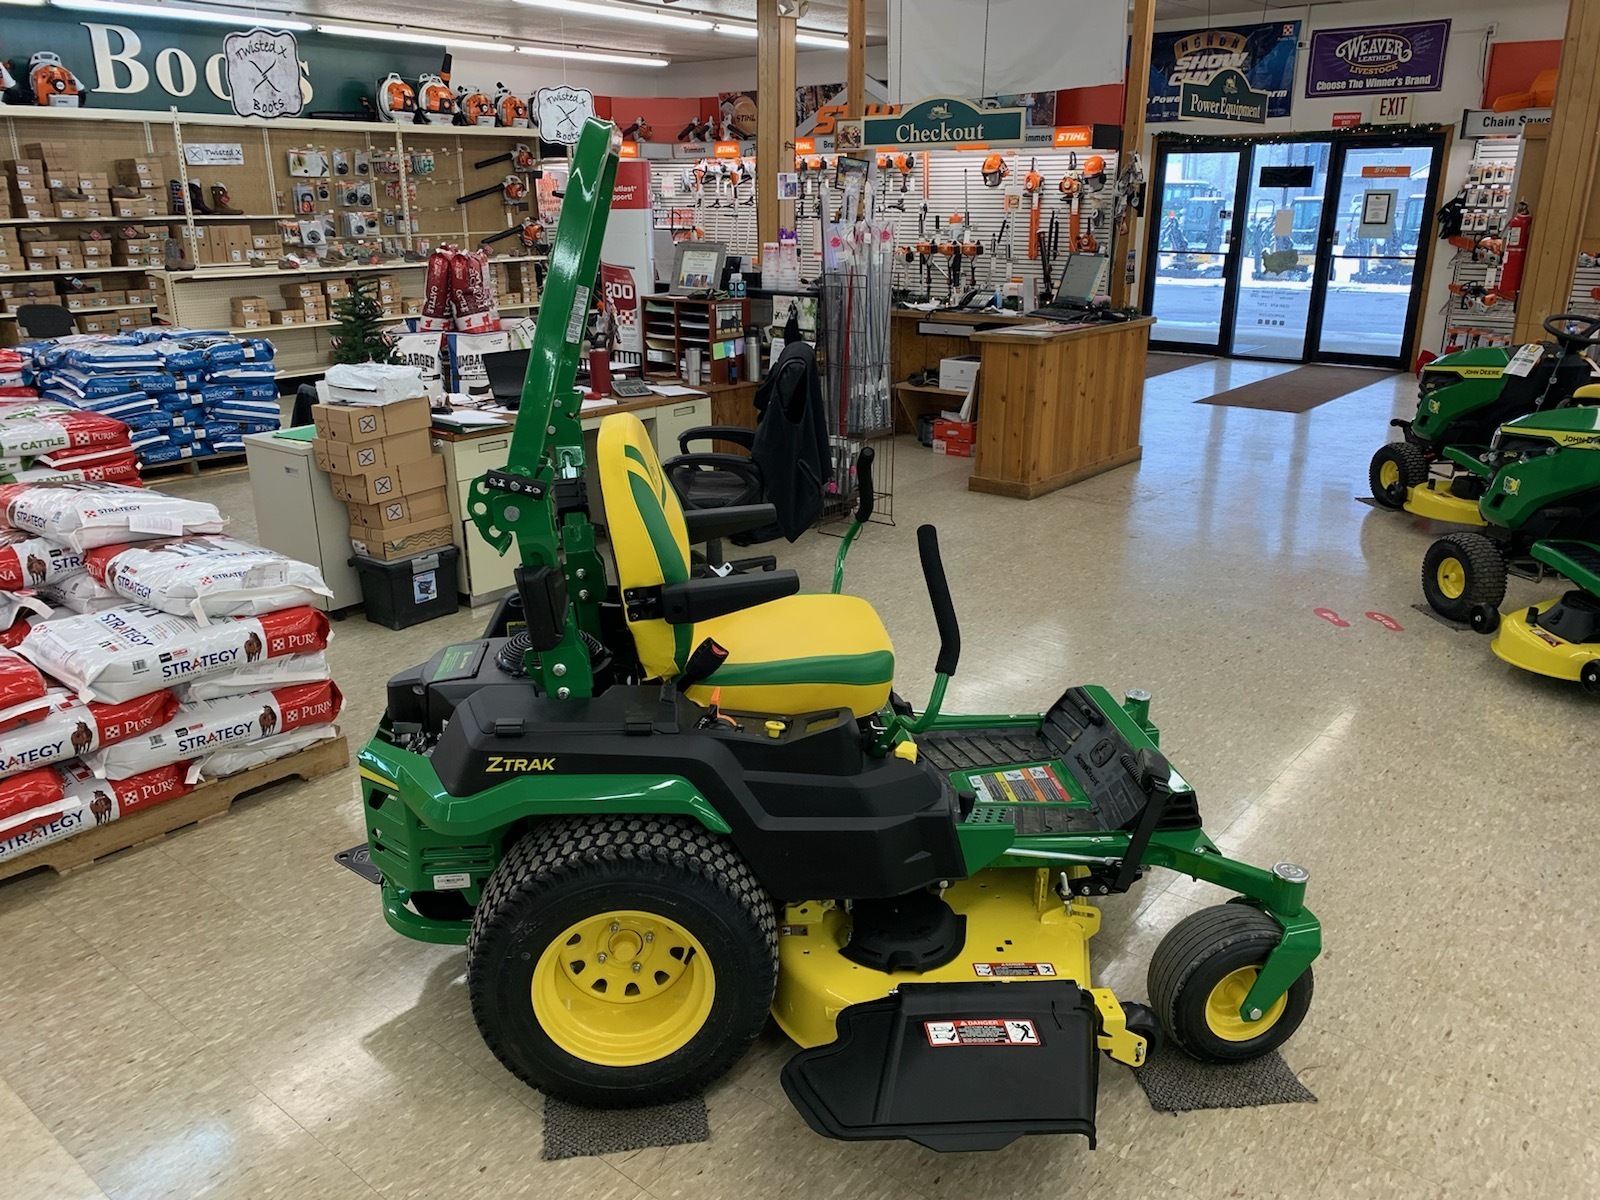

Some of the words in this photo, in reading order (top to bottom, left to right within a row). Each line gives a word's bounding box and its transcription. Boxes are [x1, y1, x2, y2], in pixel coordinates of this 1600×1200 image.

[235, 40, 276, 61] Twisted
[1336, 34, 1413, 62] WEAVER
[80, 22, 313, 105] Boos
[1174, 52, 1250, 70] SHOW
[1358, 54, 1392, 62] LEATHER
[1349, 62, 1398, 75] LIVESTOCK
[1316, 80, 1346, 90] Choose
[1348, 78, 1364, 88] The
[1366, 76, 1403, 88] Winner's
[1404, 75, 1432, 86] Brand
[252, 98, 284, 112] Boots
[546, 93, 578, 104] Twisted
[1152, 96, 1180, 104] Powe
[1380, 96, 1408, 116] EXIT
[1190, 94, 1219, 114] Power
[1220, 96, 1261, 120] Equipment
[736, 114, 756, 122] STIHL
[1483, 116, 1516, 128] Chain
[556, 130, 580, 140] Boots
[896, 122, 984, 144] Checkout
[1025, 133, 1053, 142] immers
[1056, 132, 1088, 142] STIHL
[620, 145, 636, 154] TIHL
[716, 146, 737, 154] STIHL
[605, 282, 634, 300] 200
[428, 286, 438, 314] CATTLE
[403, 353, 435, 370] BARGER
[206, 390, 234, 398] PRECON
[20, 437, 66, 450] CATTLE
[1563, 435, 1584, 443] JOHN
[148, 451, 178, 460] PRECON
[98, 506, 141, 514] STRATEGY
[16, 510, 48, 529] STRATEGY
[52, 556, 80, 570] STR
[101, 613, 154, 646] STRATEGY
[162, 648, 239, 678] STRATEGY
[302, 701, 332, 718] PURIN
[178, 721, 254, 752] STRATEGY
[0, 740, 64, 771] RATEGY
[486, 756, 556, 772] ZTRAK
[0, 810, 83, 854] STRATEGY
